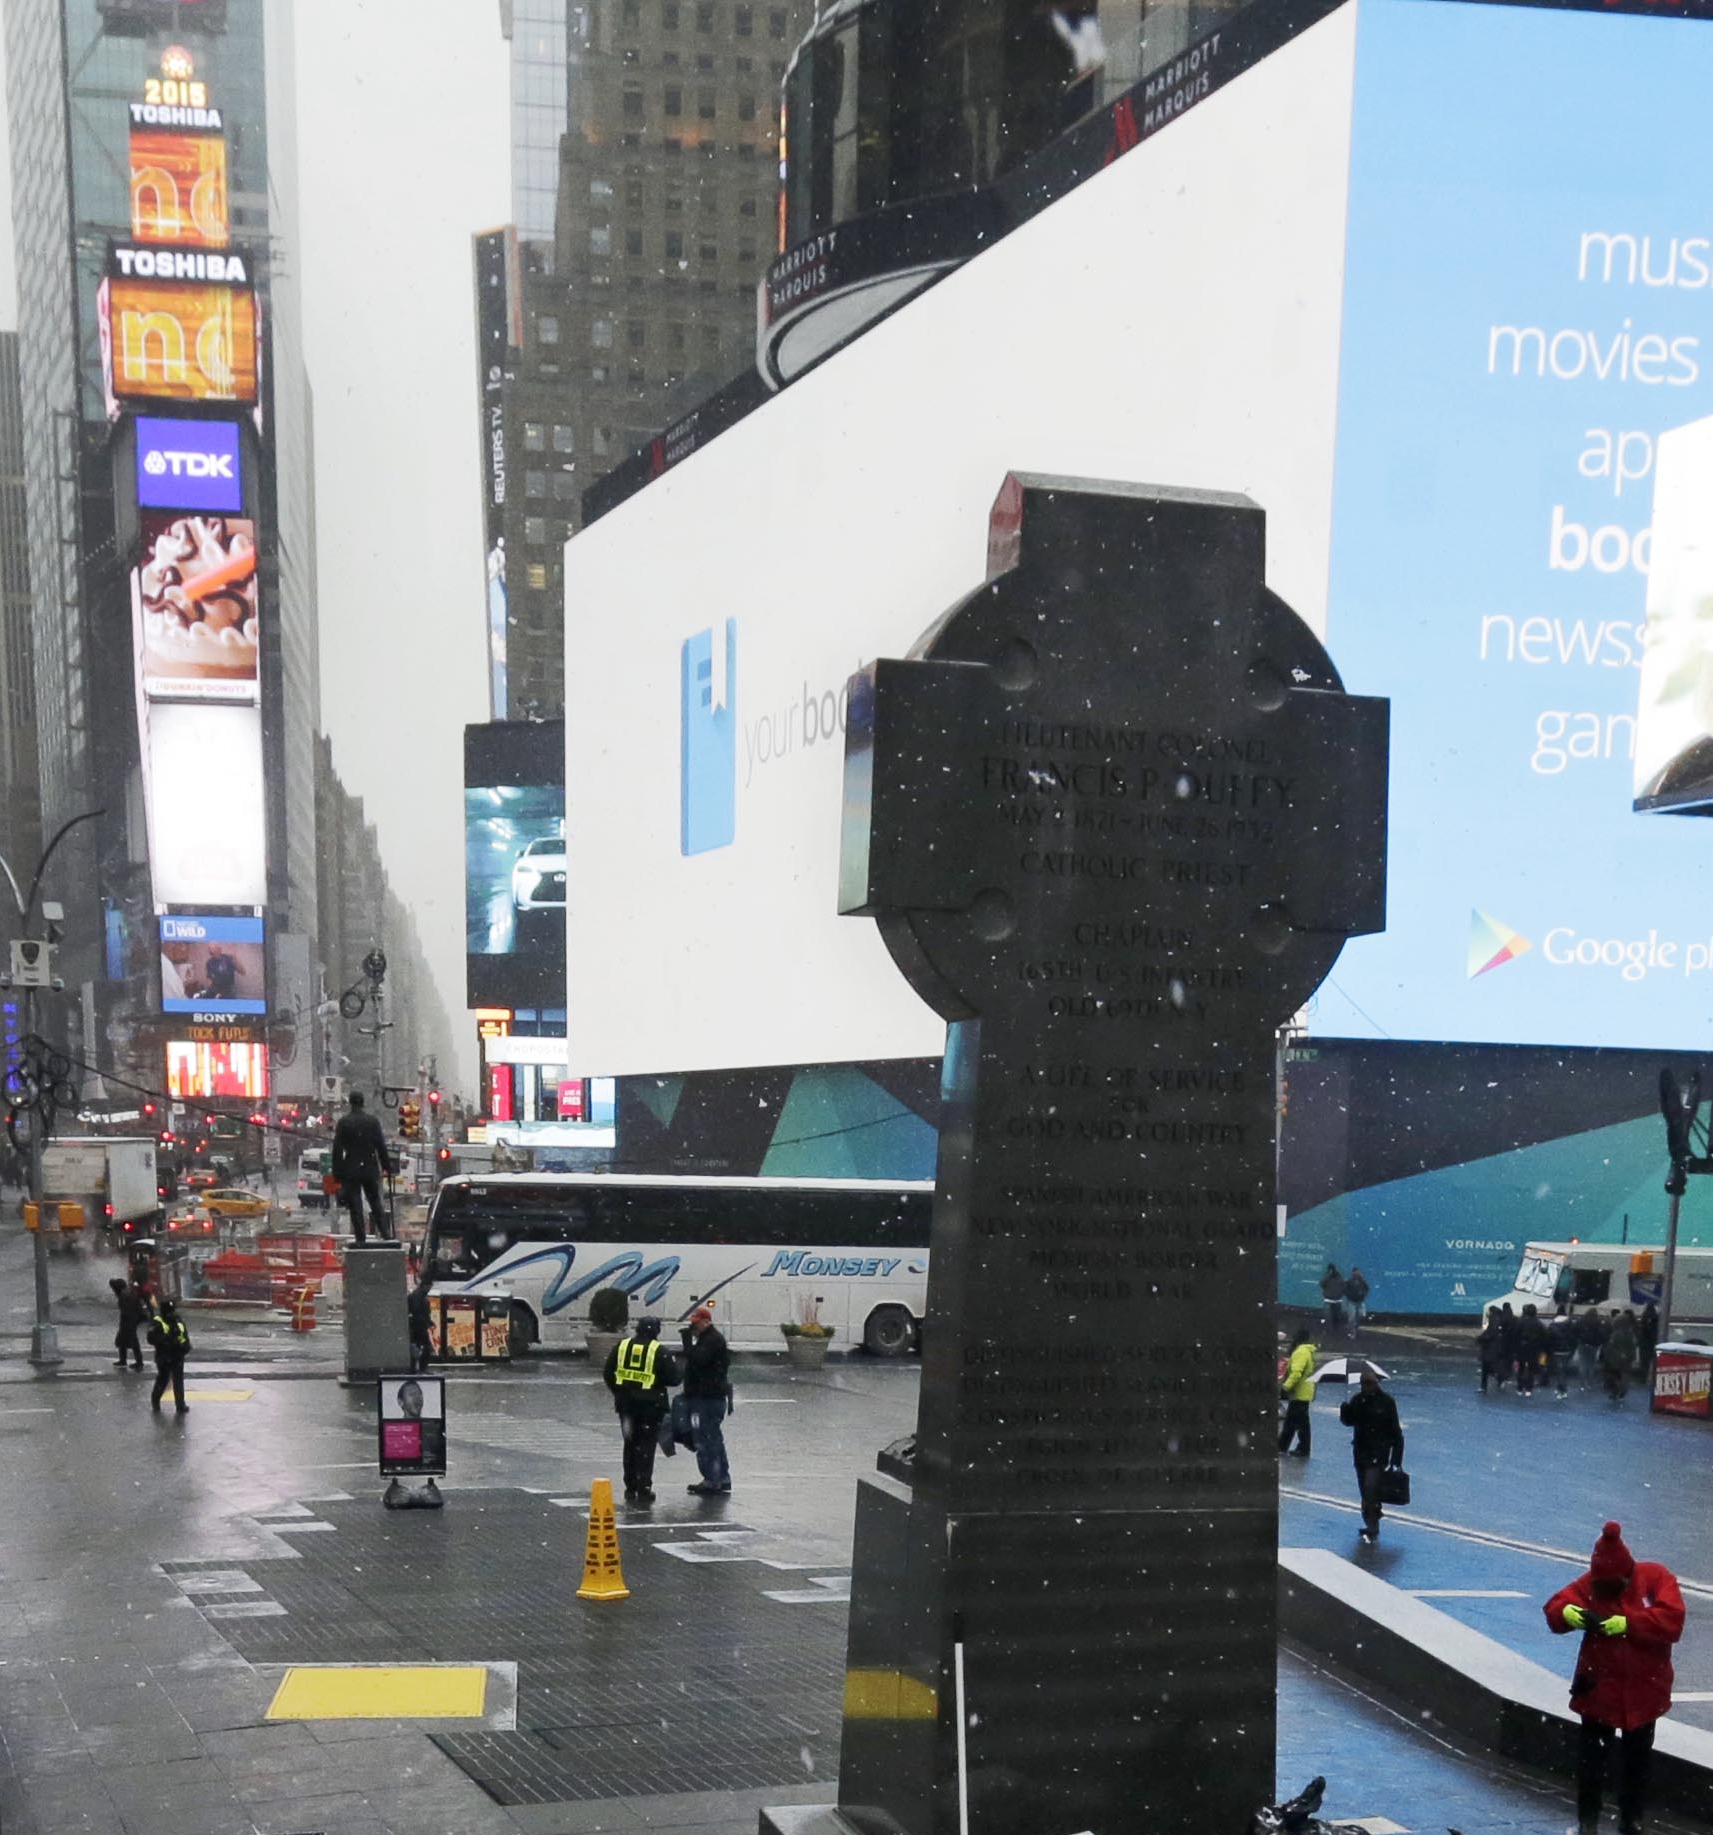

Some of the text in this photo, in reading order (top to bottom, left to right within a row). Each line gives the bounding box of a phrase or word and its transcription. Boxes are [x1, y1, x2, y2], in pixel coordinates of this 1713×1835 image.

[1145, 33, 1221, 103] MARRIOTT
[144, 79, 207, 107] 2015
[1144, 71, 1209, 130] MARQUIS
[130, 103, 222, 129] TOSHIBA
[115, 249, 247, 282] TOSHIBA
[1487, 319, 1699, 387] movies
[163, 451, 234, 479] TDK
[491, 428, 506, 504] REUTERS
[1577, 427, 1655, 496] ap
[1000, 720, 1272, 764] LIEUTENANT COLONEL
[980, 755, 1129, 800] FRANCIS
[1173, 769, 1298, 809] DUFFY
[994, 803, 1047, 827] MAY
[1019, 850, 1251, 887] CATHOLIC PRIEST
[176, 926, 207, 938] WILD
[1073, 922, 1195, 950] CHAPLAIN
[1541, 926, 1678, 981] Google
[192, 1012, 237, 1023] SONY
[1047, 995, 1097, 1018] OLD
[1148, 1068, 1246, 1094] SERVICE
[1006, 1117, 1250, 1145] GOD AND COUNTRY
[1445, 1239, 1515, 1250] VORNADO
